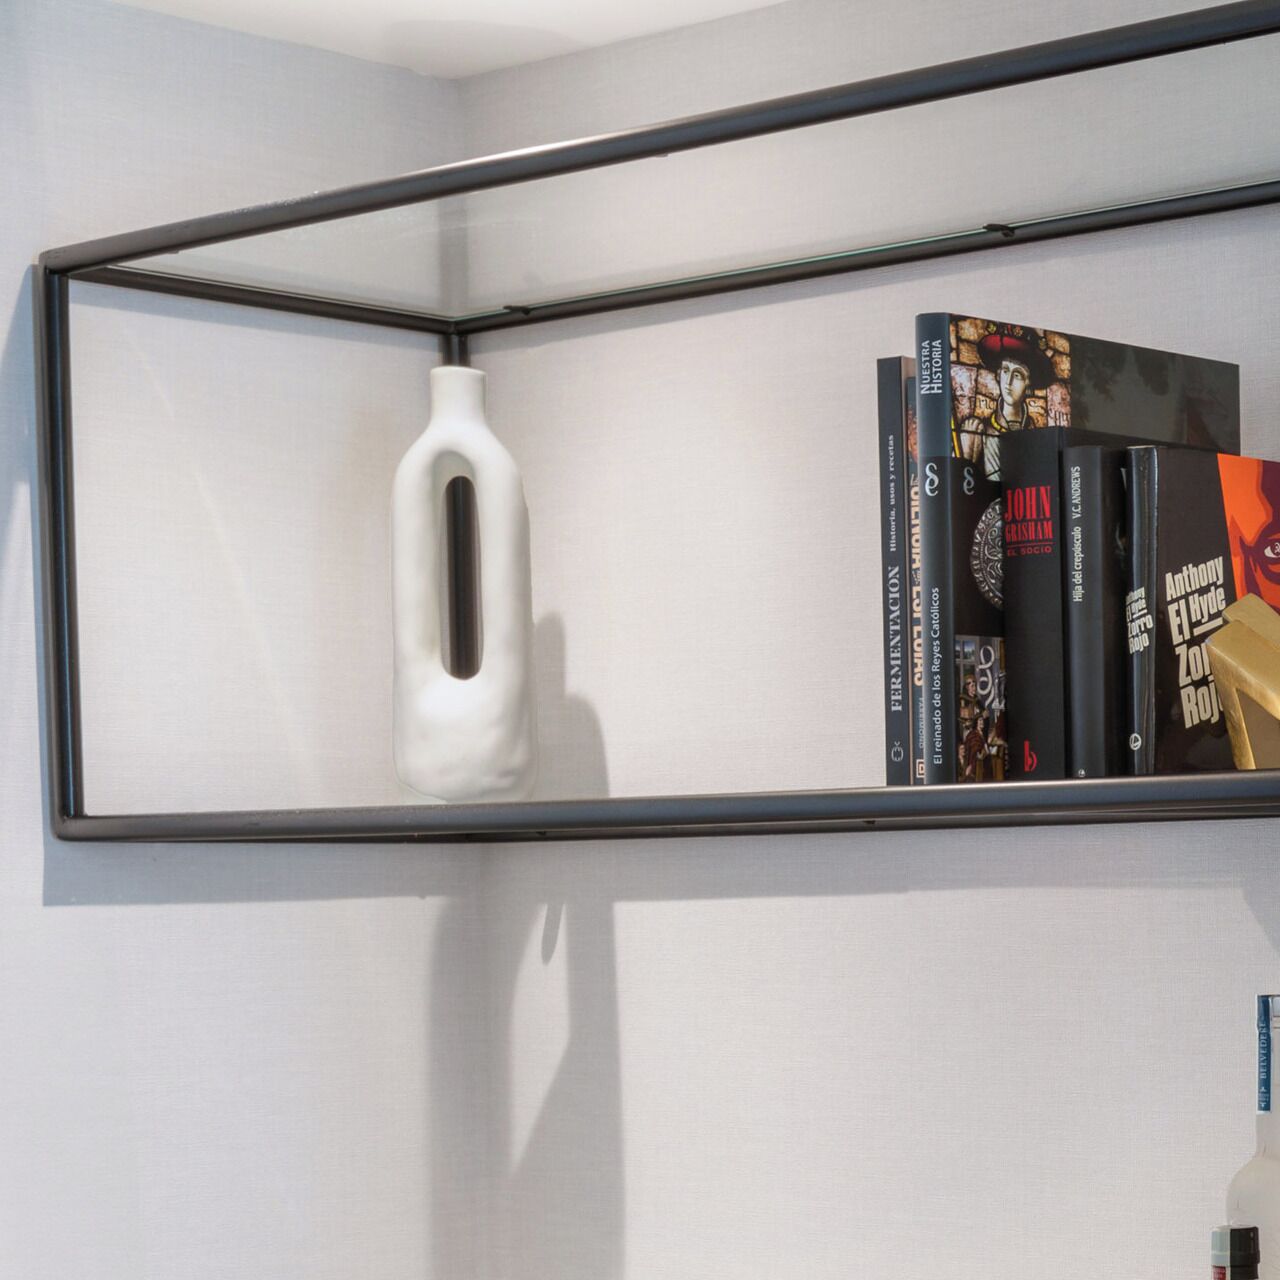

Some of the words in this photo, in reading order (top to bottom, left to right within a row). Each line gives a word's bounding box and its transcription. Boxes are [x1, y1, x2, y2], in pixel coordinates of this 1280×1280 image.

[920, 340, 930, 394] NUESTRA
[930, 340, 942, 394] HISTORIA
[1004, 486, 1050, 522] JOHN
[1005, 520, 1053, 542] GRISHAM
[1021, 546, 1052, 555] SOCIO
[1072, 526, 1084, 570] crepúsculo
[1072, 571, 1082, 584] del
[1072, 586, 1084, 602] Hija
[1165, 556, 1224, 602] Anthony
[930, 587, 940, 638] Católicos
[1128, 614, 1154, 638] Zorro
[1168, 599, 1190, 646] El
[1188, 586, 1226, 623] Hyde
[888, 566, 903, 712] FERMENTACIÓN
[931, 640, 942, 672] Reyes
[1130, 632, 1149, 654] Rojo
[931, 675, 941, 690] los
[1175, 642, 1212, 688] Zor
[932, 693, 942, 707] de
[1180, 676, 1224, 730] Roj
[932, 710, 942, 752] reinado
[934, 754, 942, 765] El
[1258, 1023, 1268, 1080] BELVEDERE
